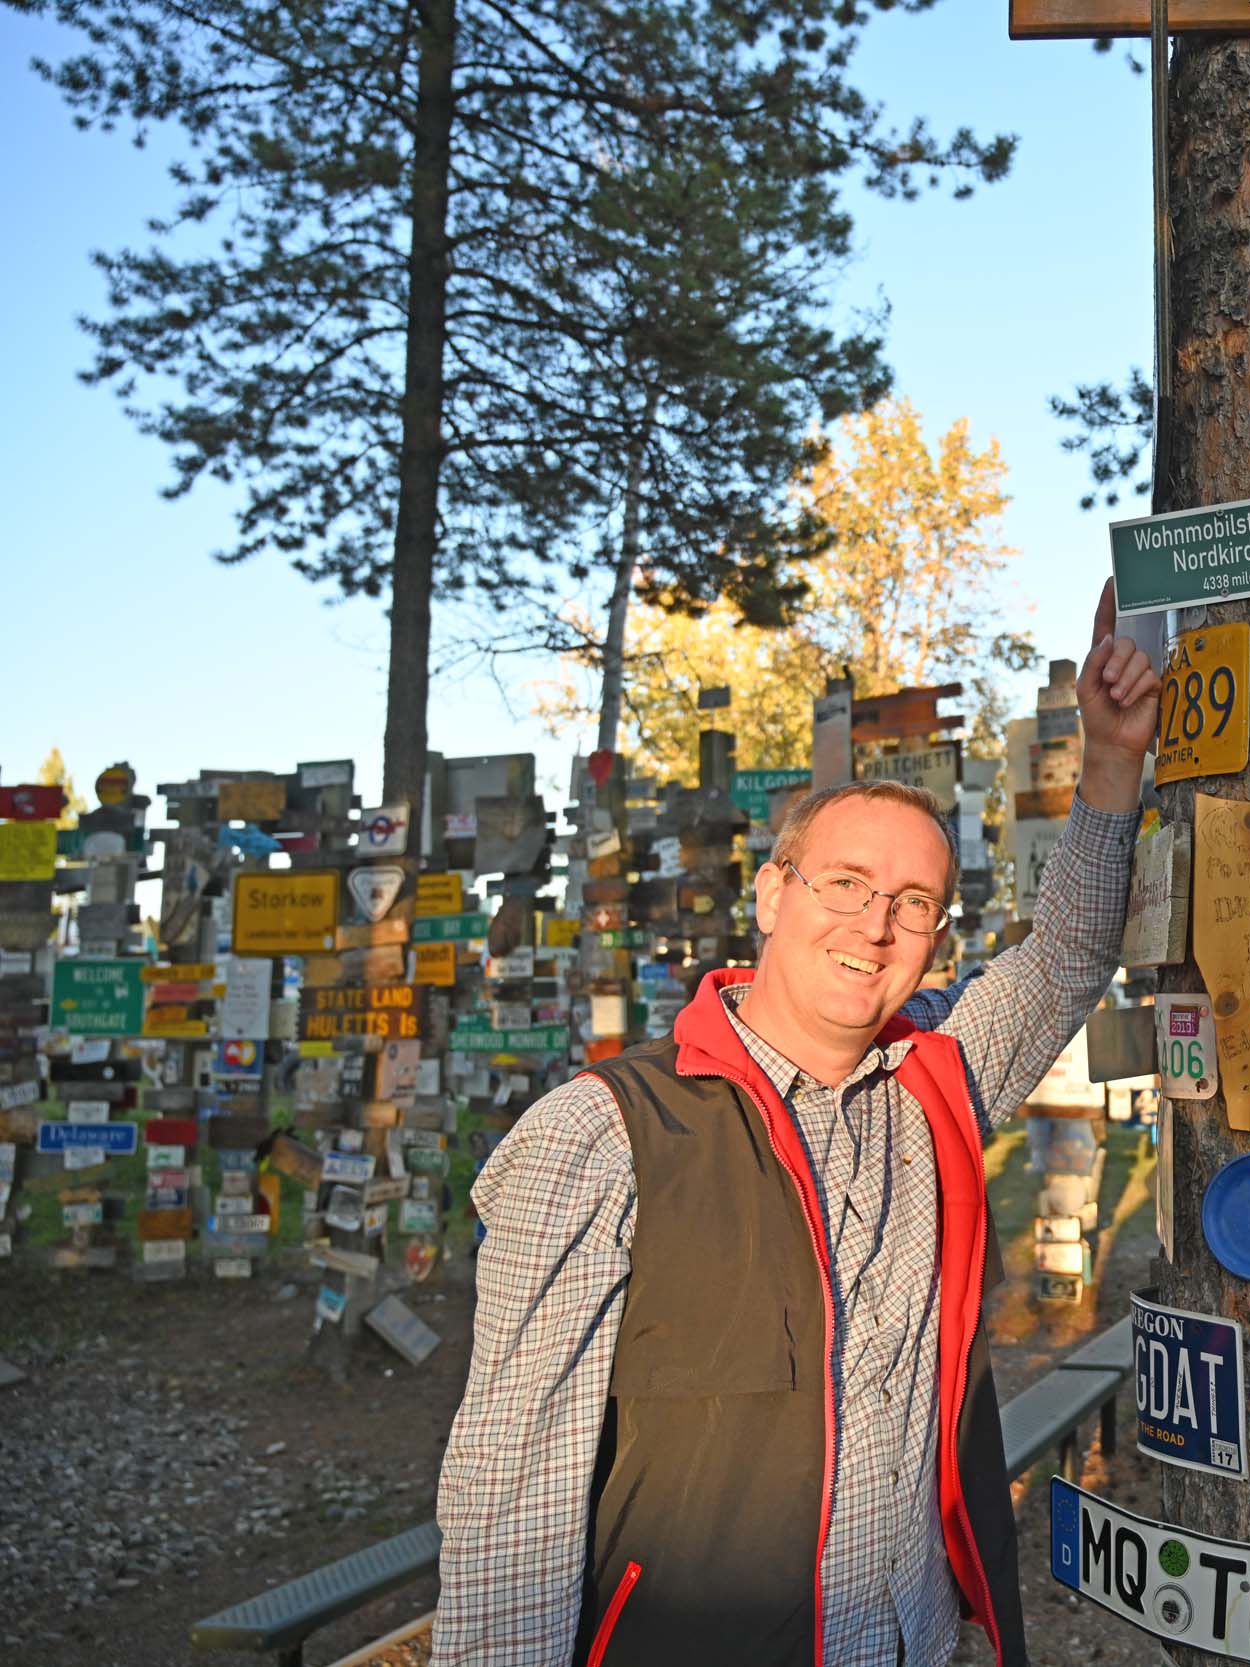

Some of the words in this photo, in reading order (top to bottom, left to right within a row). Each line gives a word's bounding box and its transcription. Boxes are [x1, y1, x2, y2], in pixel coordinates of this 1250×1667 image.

[1203, 574, 1230, 591] 4338
[1165, 666, 1236, 748] 289
[864, 750, 953, 778] PRITCHETT
[371, 986, 413, 1008] LAND
[1140, 1421, 1155, 1437] THE
[1156, 1428, 1186, 1447] ROAD
[1217, 1451, 1234, 1467] 17
[1061, 1543, 1073, 1566] D
[1081, 1507, 1148, 1615] MQ
